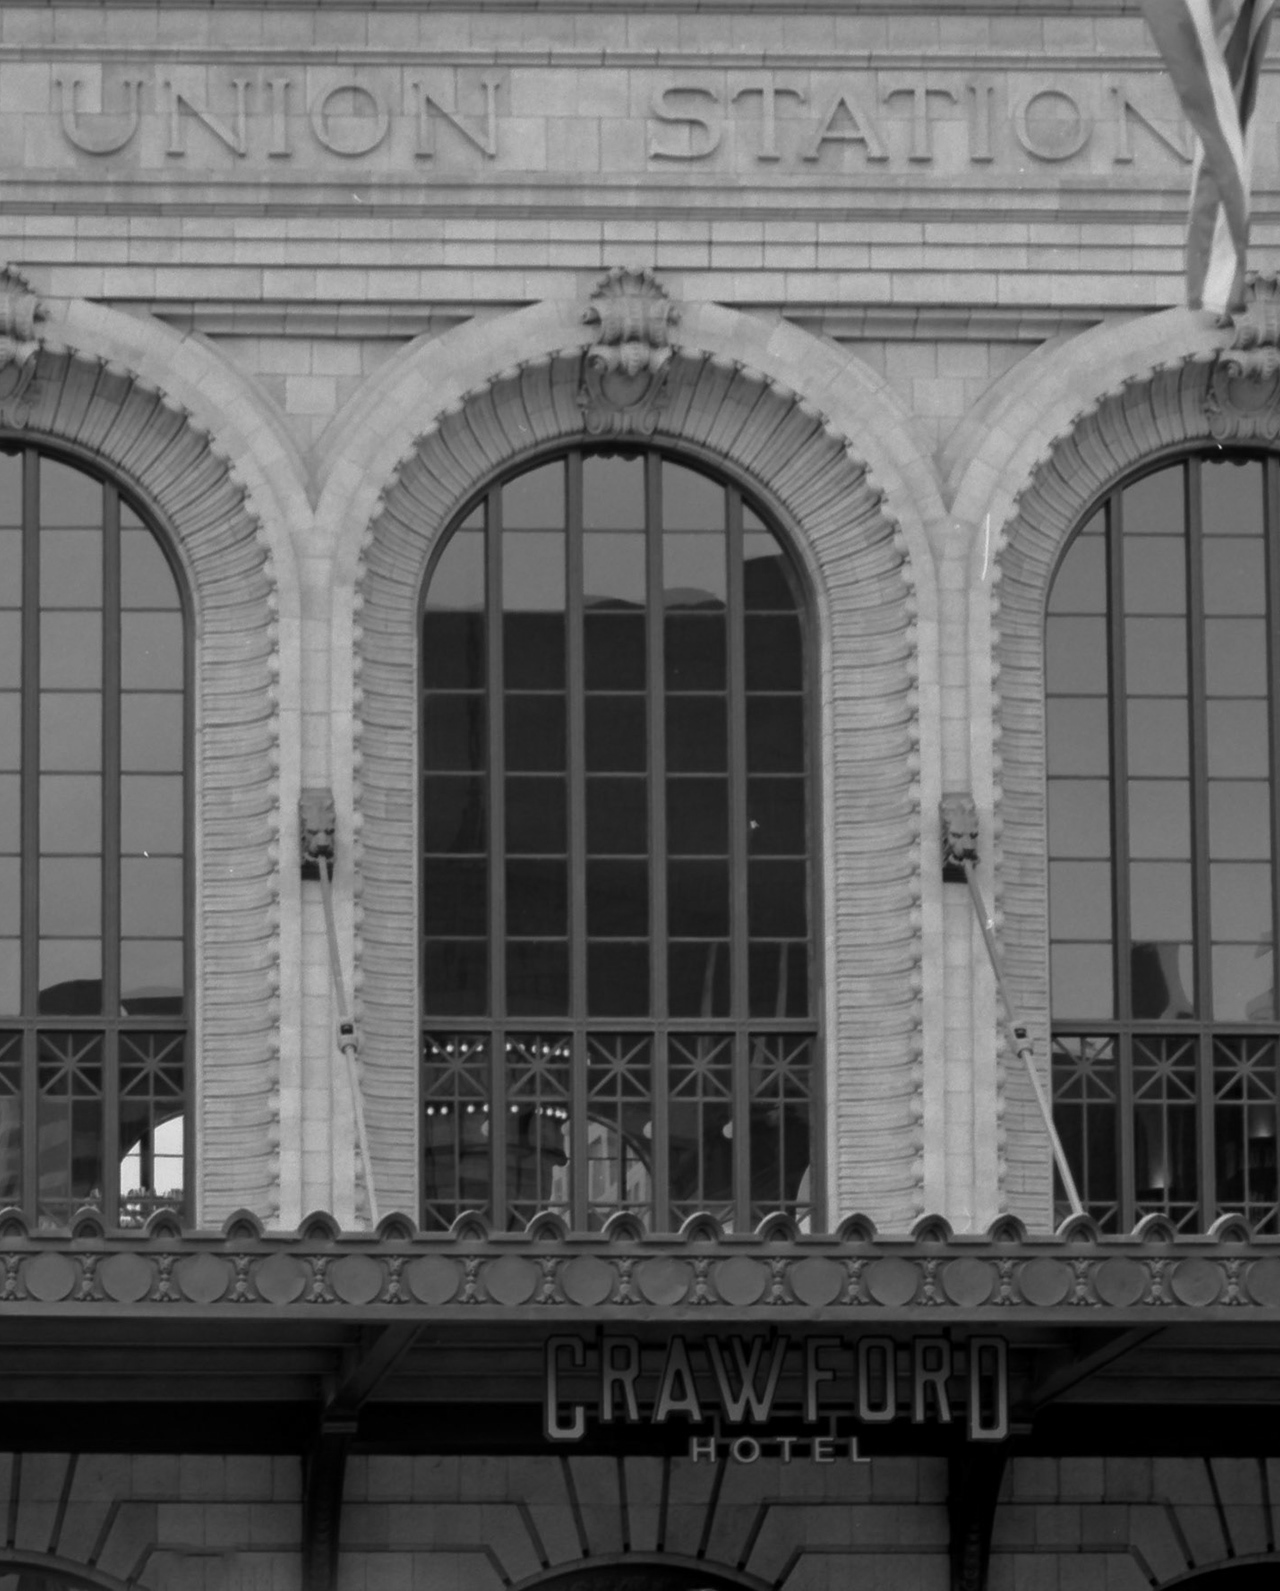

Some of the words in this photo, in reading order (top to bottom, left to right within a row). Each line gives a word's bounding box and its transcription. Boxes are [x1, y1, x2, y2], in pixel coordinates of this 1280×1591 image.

[54, 78, 501, 160] UNION
[649, 85, 1196, 165] STATION
[544, 1333, 1011, 1441] CRAWFORD
[690, 1436, 873, 1464] HOTEL
